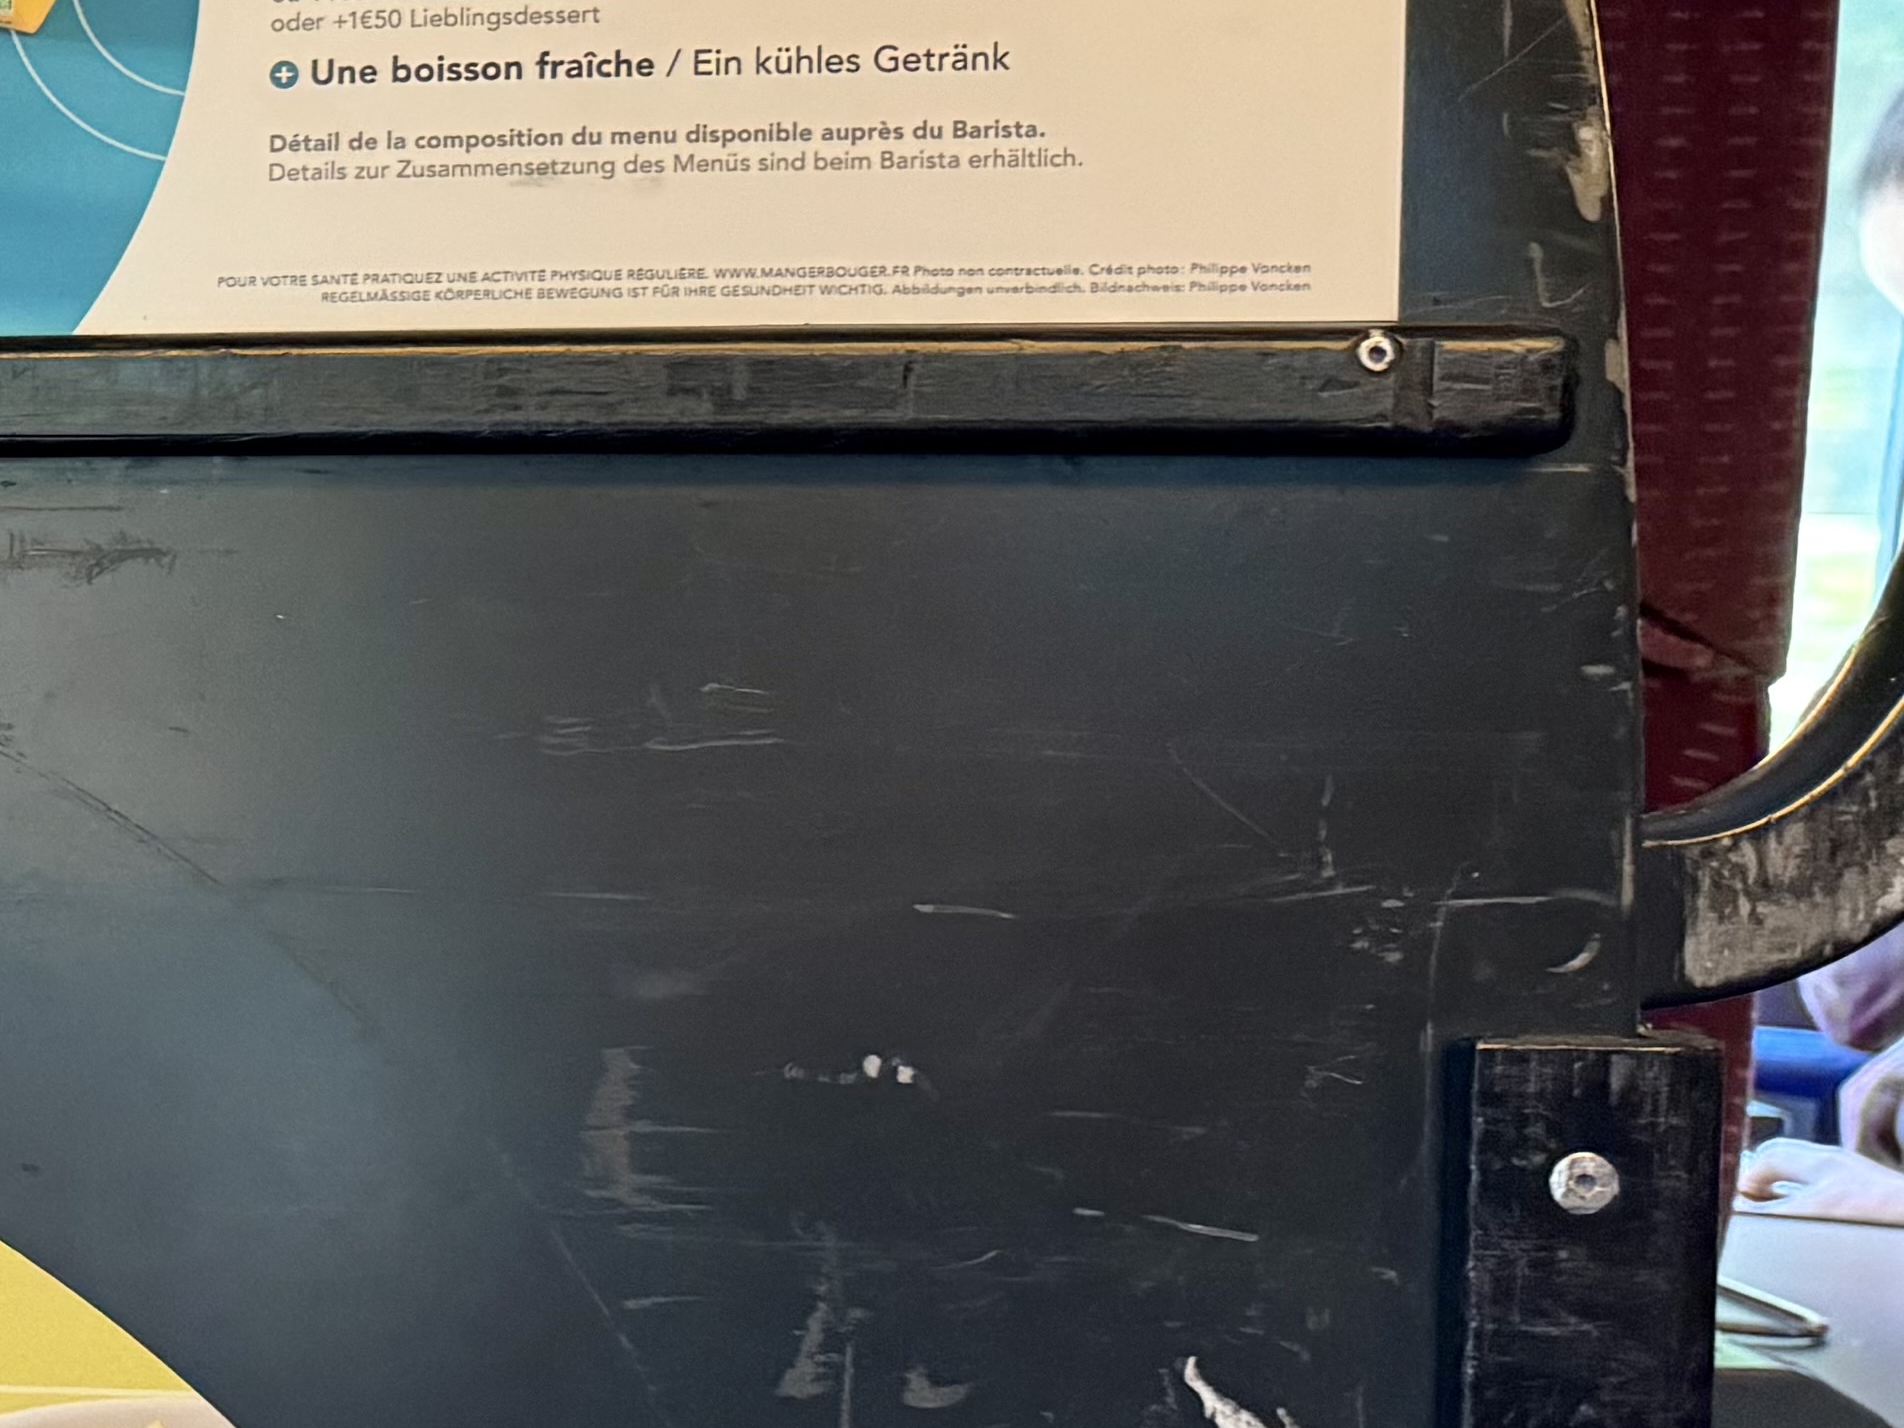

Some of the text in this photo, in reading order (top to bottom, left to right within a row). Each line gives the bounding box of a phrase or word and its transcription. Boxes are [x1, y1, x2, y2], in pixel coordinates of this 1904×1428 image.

[269, 4, 601, 33] oder +1€50 Lieblingsdessert
[310, 57, 379, 86] Une
[391, 54, 523, 84] boisson
[534, 48, 656, 80] fraîche
[693, 48, 743, 77] Ein
[755, 43, 862, 76] kühles
[873, 40, 1011, 74] Getränk
[268, 118, 1047, 154] Détail de la composition du menu disponible auprès du Barista.
[268, 145, 1084, 184] Details zur Zusammensetzung des Menüs sind beim Barista erhältlich.
